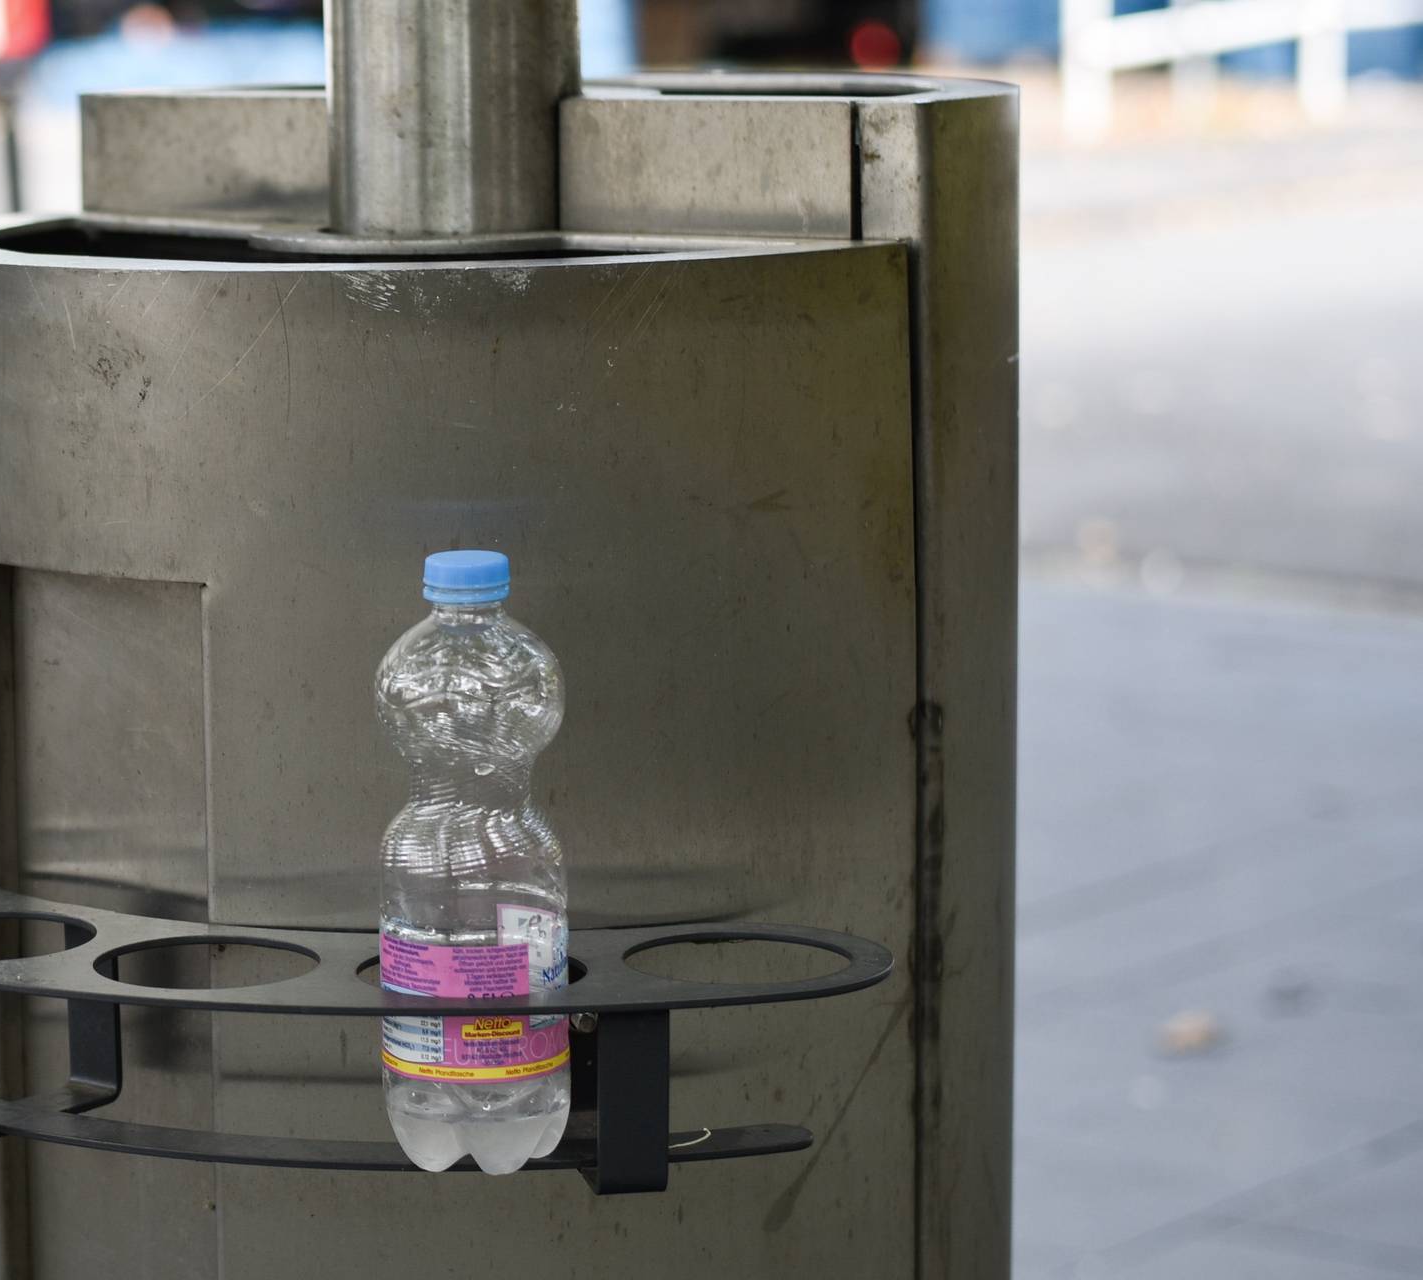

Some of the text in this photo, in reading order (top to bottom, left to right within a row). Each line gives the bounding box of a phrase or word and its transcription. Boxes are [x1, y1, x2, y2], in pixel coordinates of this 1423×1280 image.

[473, 1016, 514, 1030] Netto
[464, 1029, 521, 1038] Marken-Discount
[418, 1067, 475, 1077] Netto Pfandflasche
[505, 1061, 554, 1076] Netto Pfandflasche
